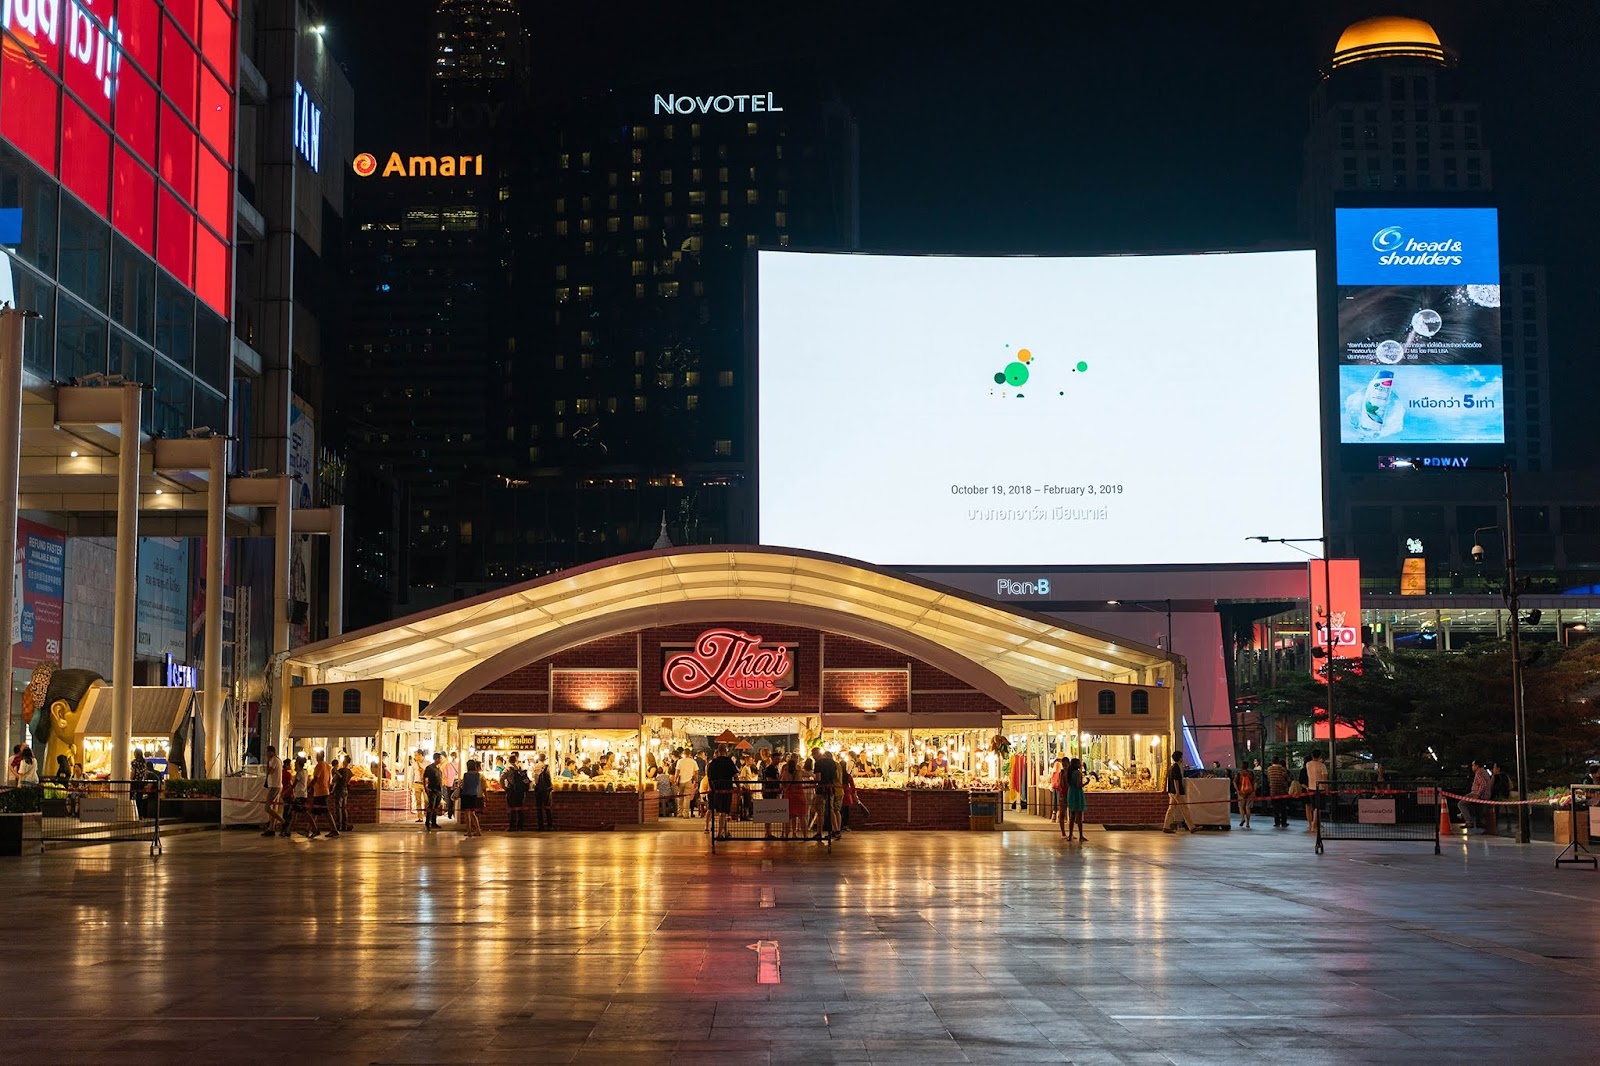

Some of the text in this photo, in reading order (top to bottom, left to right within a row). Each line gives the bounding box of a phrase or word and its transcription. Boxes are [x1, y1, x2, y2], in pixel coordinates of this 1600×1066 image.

[654, 92, 783, 114] NOVOTEL
[382, 151, 482, 177] Amari
[1379, 252, 1462, 265] shoulders
[1409, 397, 1460, 408] เหนือกว่า
[951, 484, 988, 495] October
[992, 485, 1006, 496] 19,
[1009, 485, 1032, 495] 2018
[1043, 484, 1085, 497] February
[1088, 485, 1097, 495] 3,
[1099, 484, 1123, 494] 2019
[665, 630, 790, 706] Thai
[725, 677, 773, 689] Cuisine
